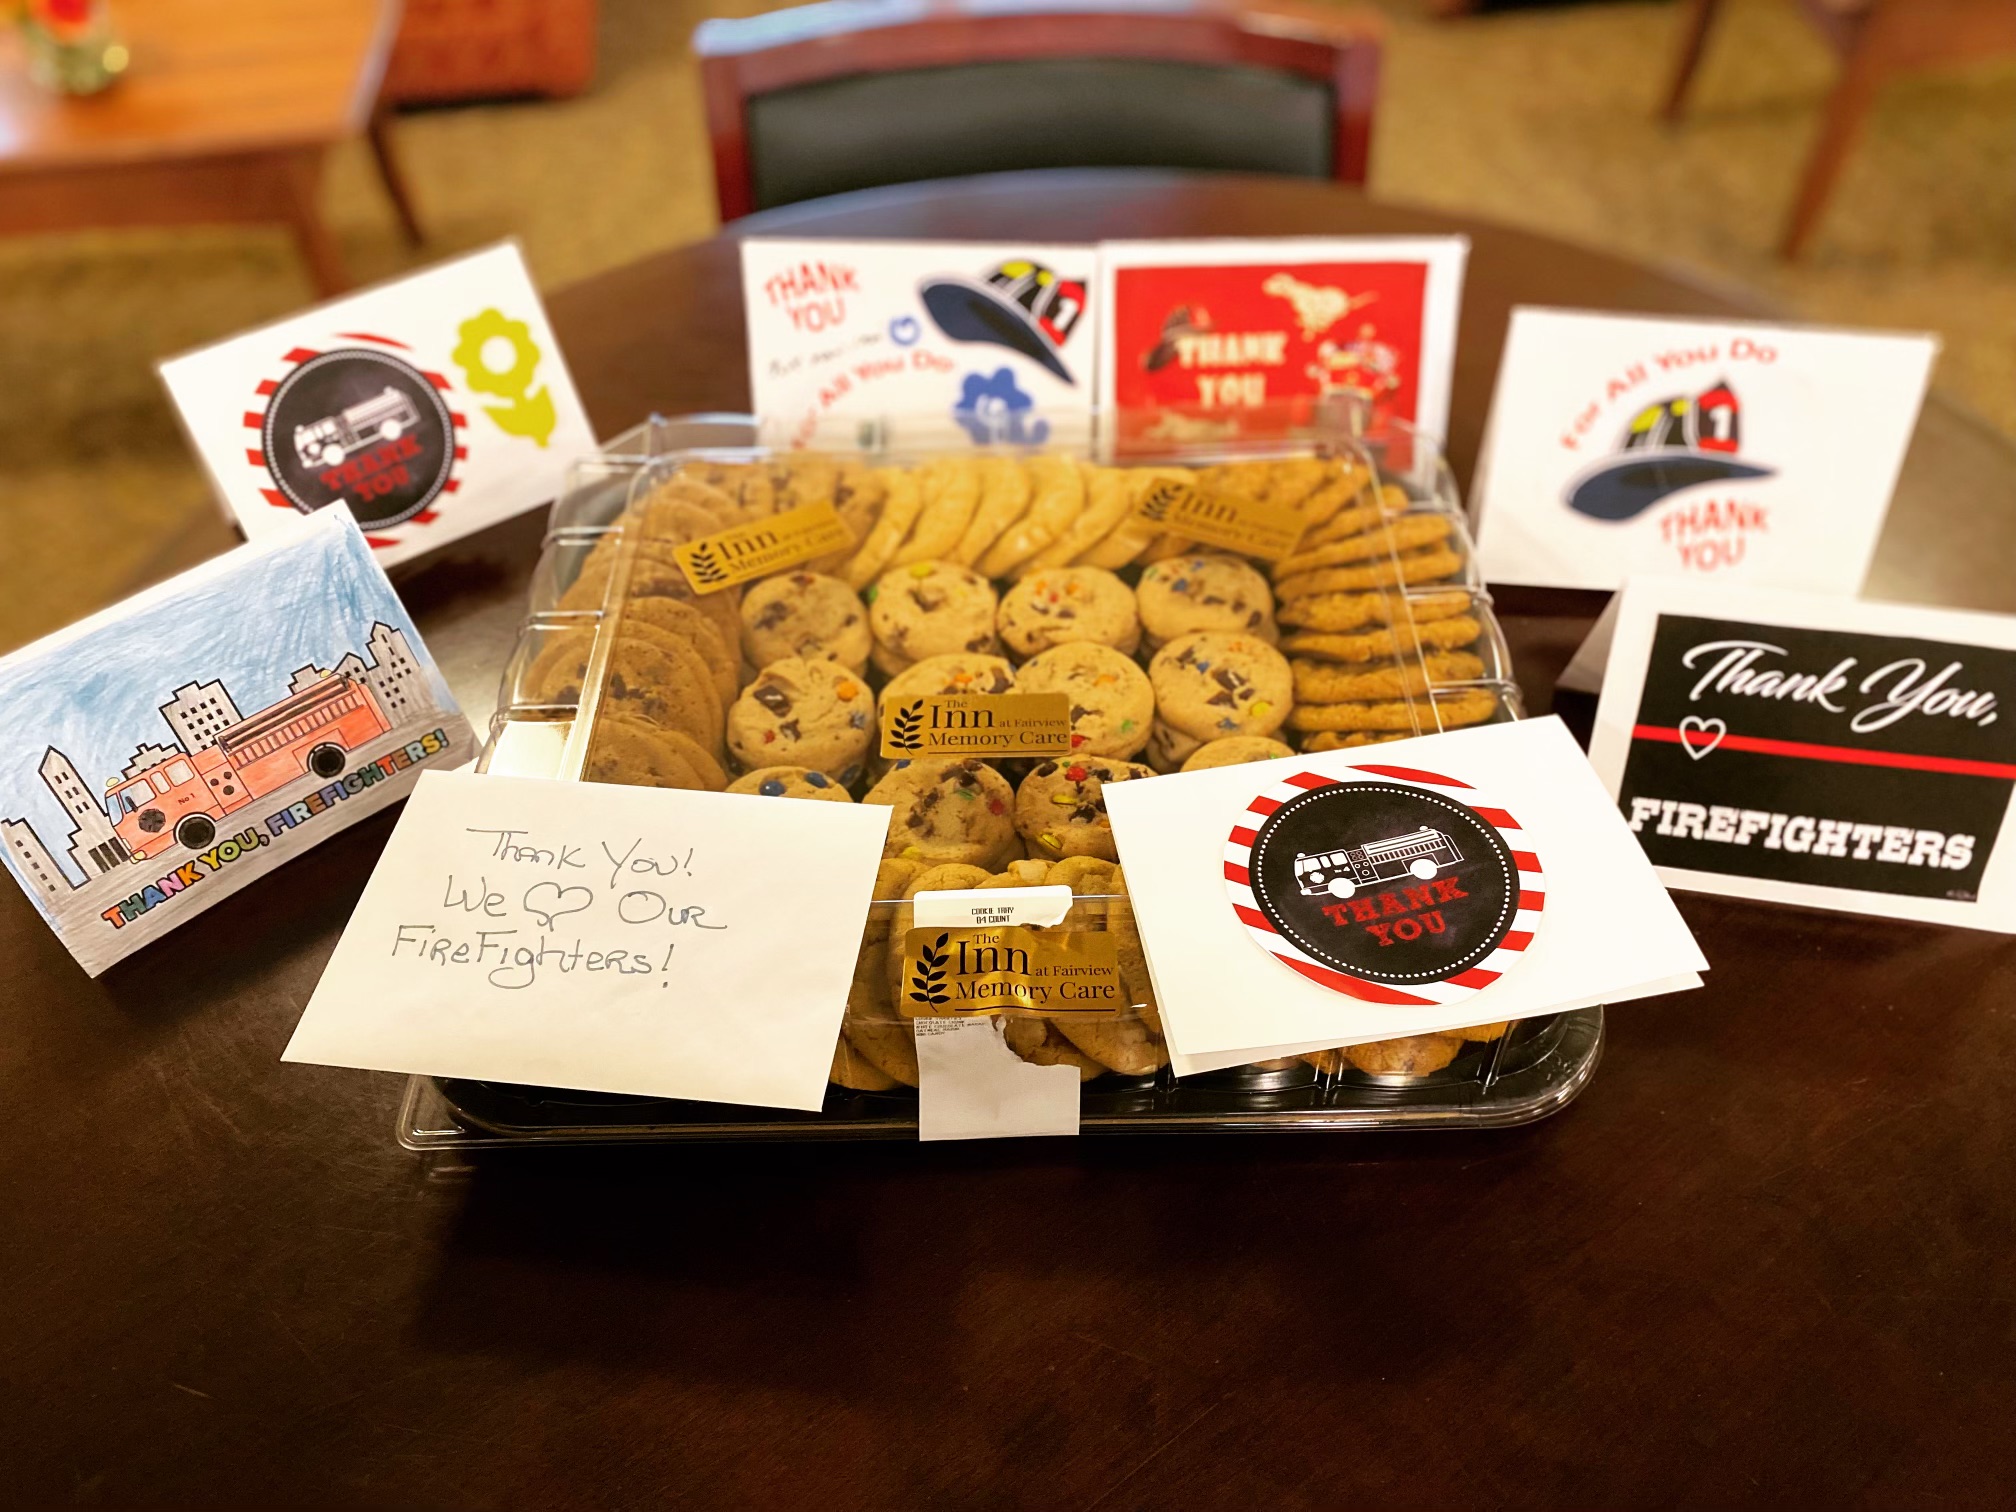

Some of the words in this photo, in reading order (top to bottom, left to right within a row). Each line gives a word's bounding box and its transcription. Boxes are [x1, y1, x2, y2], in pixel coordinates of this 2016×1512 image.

[764, 261, 860, 306] THANK
[787, 297, 845, 332] YOU
[855, 355, 905, 381] You
[911, 349, 955, 375] Do
[1175, 331, 1287, 368] THANK
[1196, 371, 1266, 411] YOU
[1560, 402, 1602, 451] For
[1605, 361, 1647, 401] All
[1654, 347, 1717, 373] You
[1729, 337, 1779, 364] Do
[1710, 405, 1729, 441] 1
[320, 434, 422, 491] THANK
[352, 462, 411, 501] YOU
[1661, 499, 1769, 544] THANK
[718, 531, 778, 560] Inn
[1676, 538, 1745, 571] YOU
[946, 700, 968, 708] The
[1682, 640, 1858, 713] Thank
[1850, 658, 1998, 733] You,
[929, 705, 995, 729] Inn
[1000, 720, 1011, 728] at
[1014, 718, 1067, 728] Fairview
[928, 731, 1015, 748] Memory
[1020, 731, 1067, 745] Care
[100, 860, 204, 930] THANK
[197, 827, 270, 873] YOU,
[265, 728, 449, 837] FIREFIGHTERS!
[1629, 796, 1976, 871] FIREFIGHTERS
[466, 828, 586, 870] Thank
[601, 838, 693, 889] You!
[444, 874, 506, 917] We
[1322, 876, 1469, 927] THANK
[989, 915, 1010, 923] COUNT
[1366, 910, 1446, 947] YOU
[973, 934, 1000, 944] The
[956, 941, 1031, 976] Inn
[1035, 966, 1049, 977] at
[1053, 965, 1113, 977] Fairview
[956, 981, 1052, 1004] Memory
[1060, 981, 1115, 999] Care
